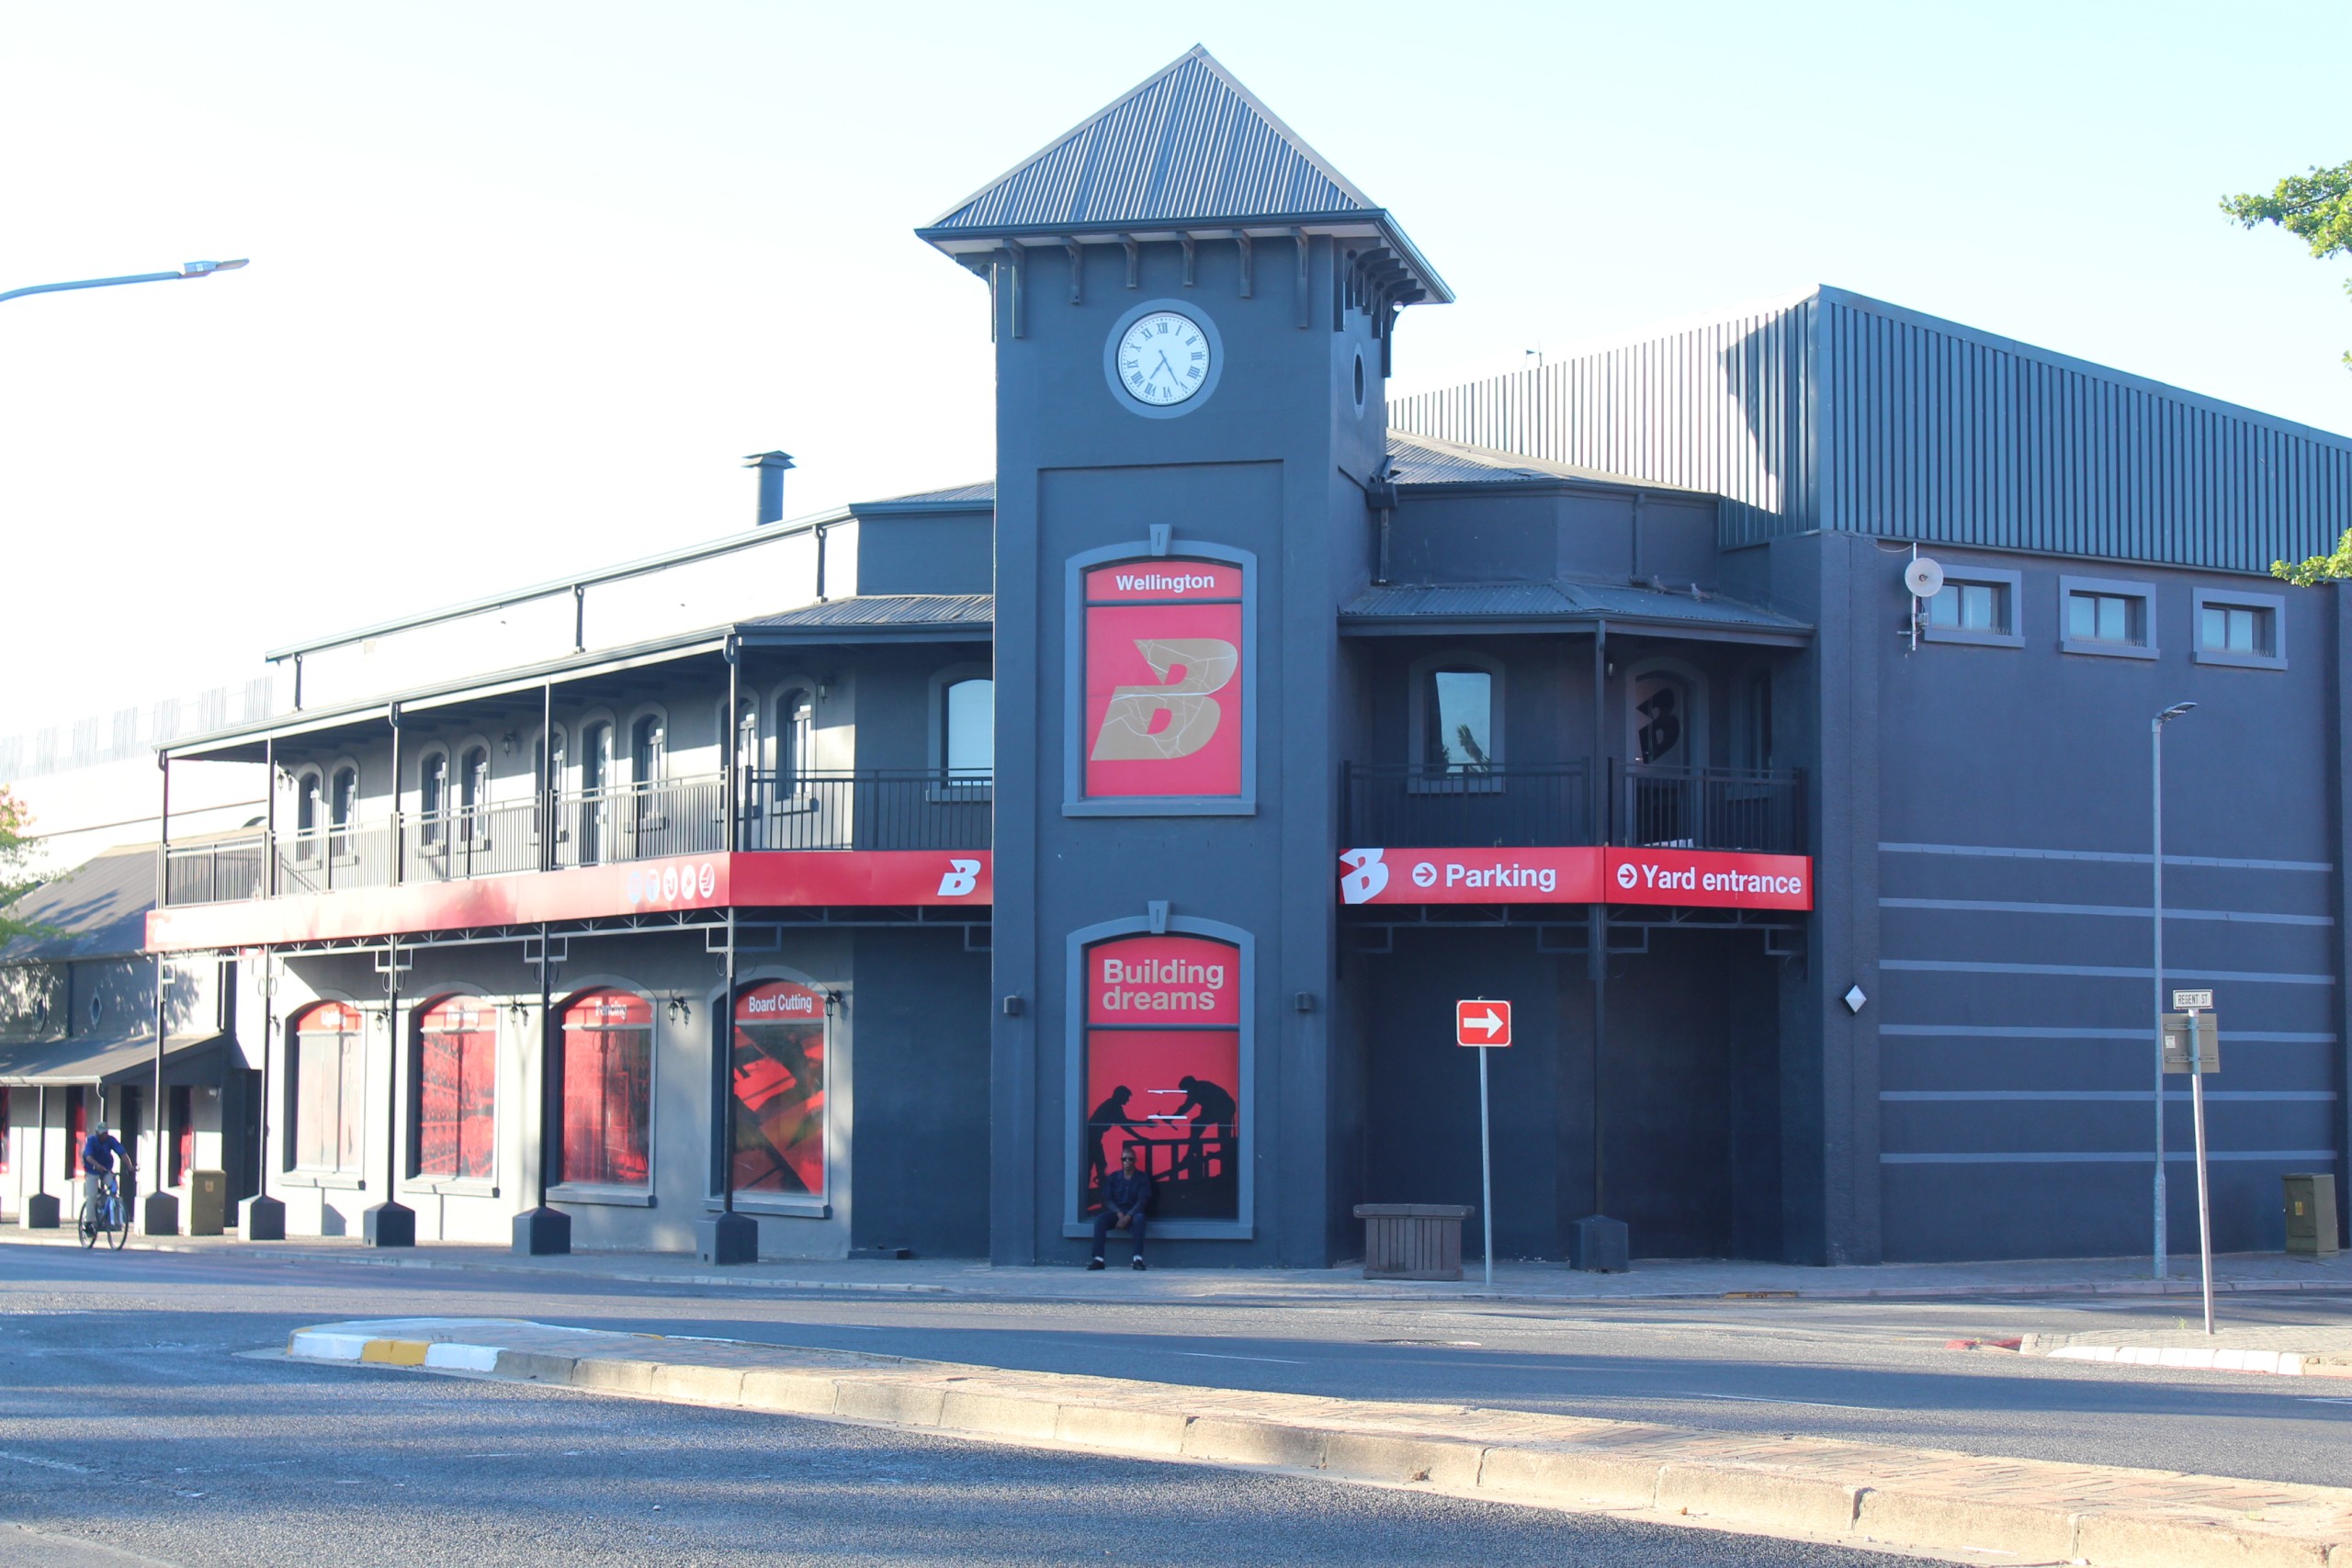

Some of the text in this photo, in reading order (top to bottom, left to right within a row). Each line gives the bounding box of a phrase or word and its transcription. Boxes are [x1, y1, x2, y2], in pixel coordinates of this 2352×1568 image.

[1115, 574, 1215, 593] Wellington
[1091, 637, 1238, 761] B
[937, 859, 981, 896] B
[1446, 863, 1556, 893] Parking
[1641, 863, 1803, 894] Yard entrance
[1103, 959, 1224, 989] Building
[594, 1000, 628, 1020] Fencing
[749, 993, 812, 1013] Board Cutting
[1102, 986, 1215, 1010] dreams
[2178, 994, 2208, 1005] REGENT ST
